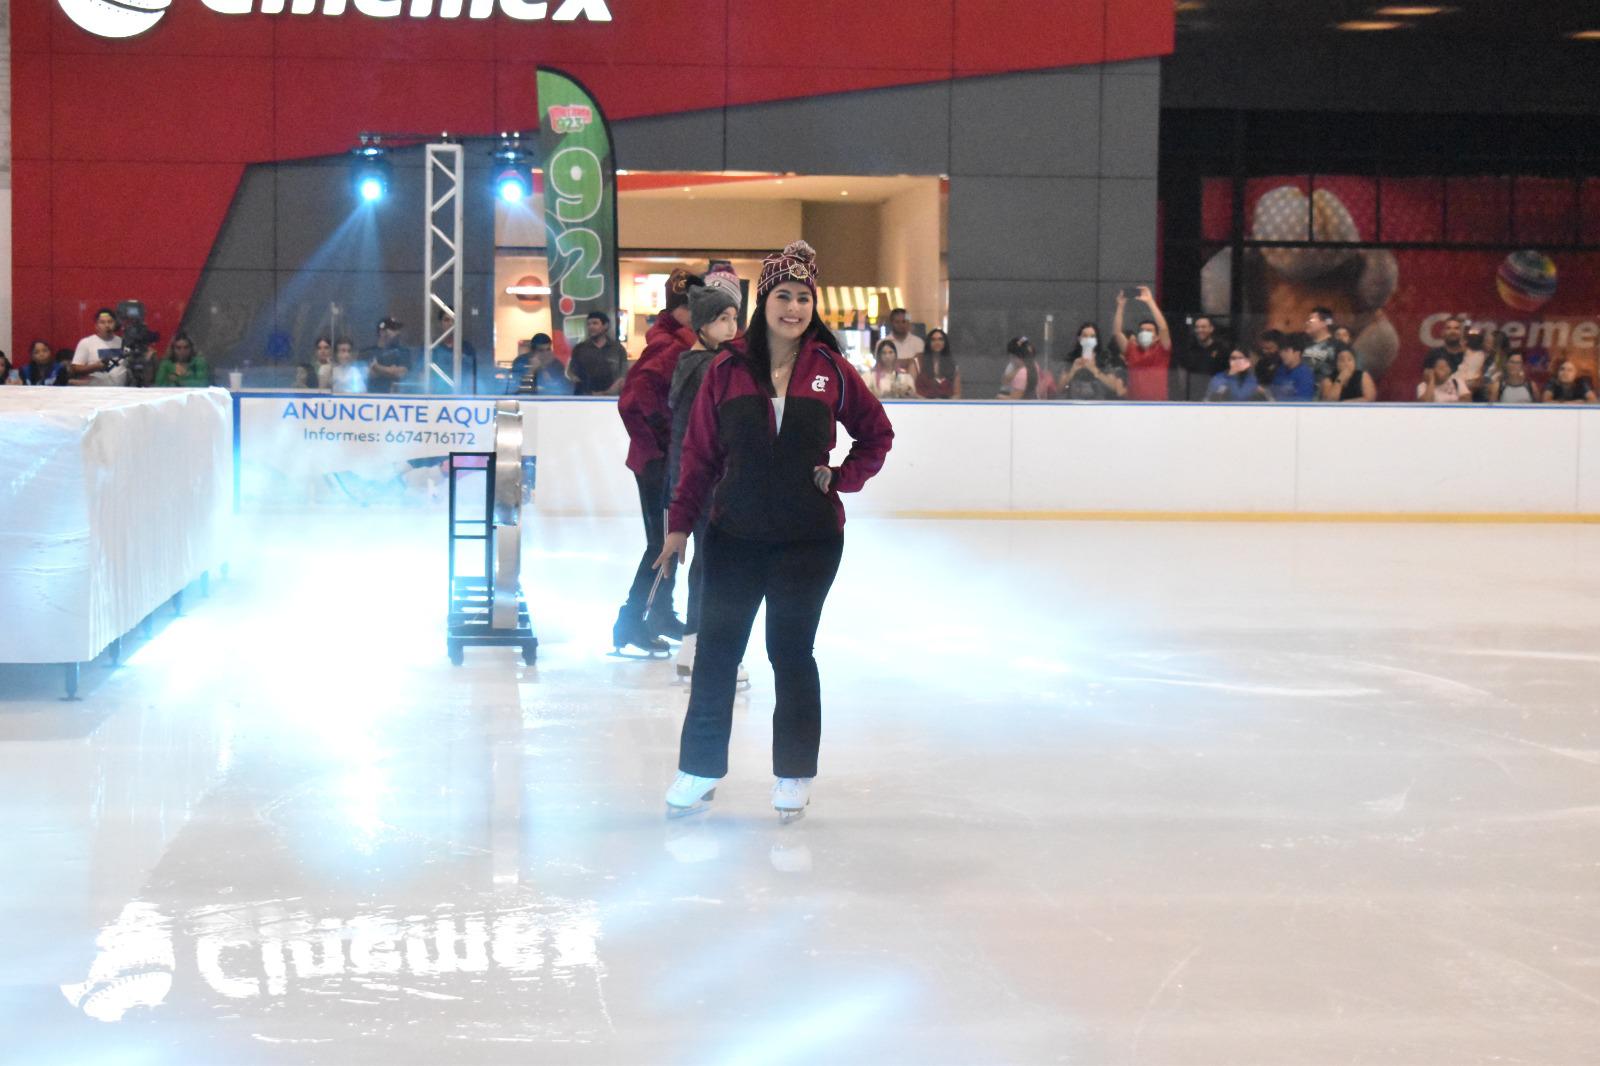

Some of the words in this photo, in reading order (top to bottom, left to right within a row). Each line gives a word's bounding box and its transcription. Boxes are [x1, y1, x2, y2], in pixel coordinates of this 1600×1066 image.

[550, 147, 604, 381] 92.
[304, 427, 380, 442] Informes:
[384, 430, 476, 445] 6674716172
